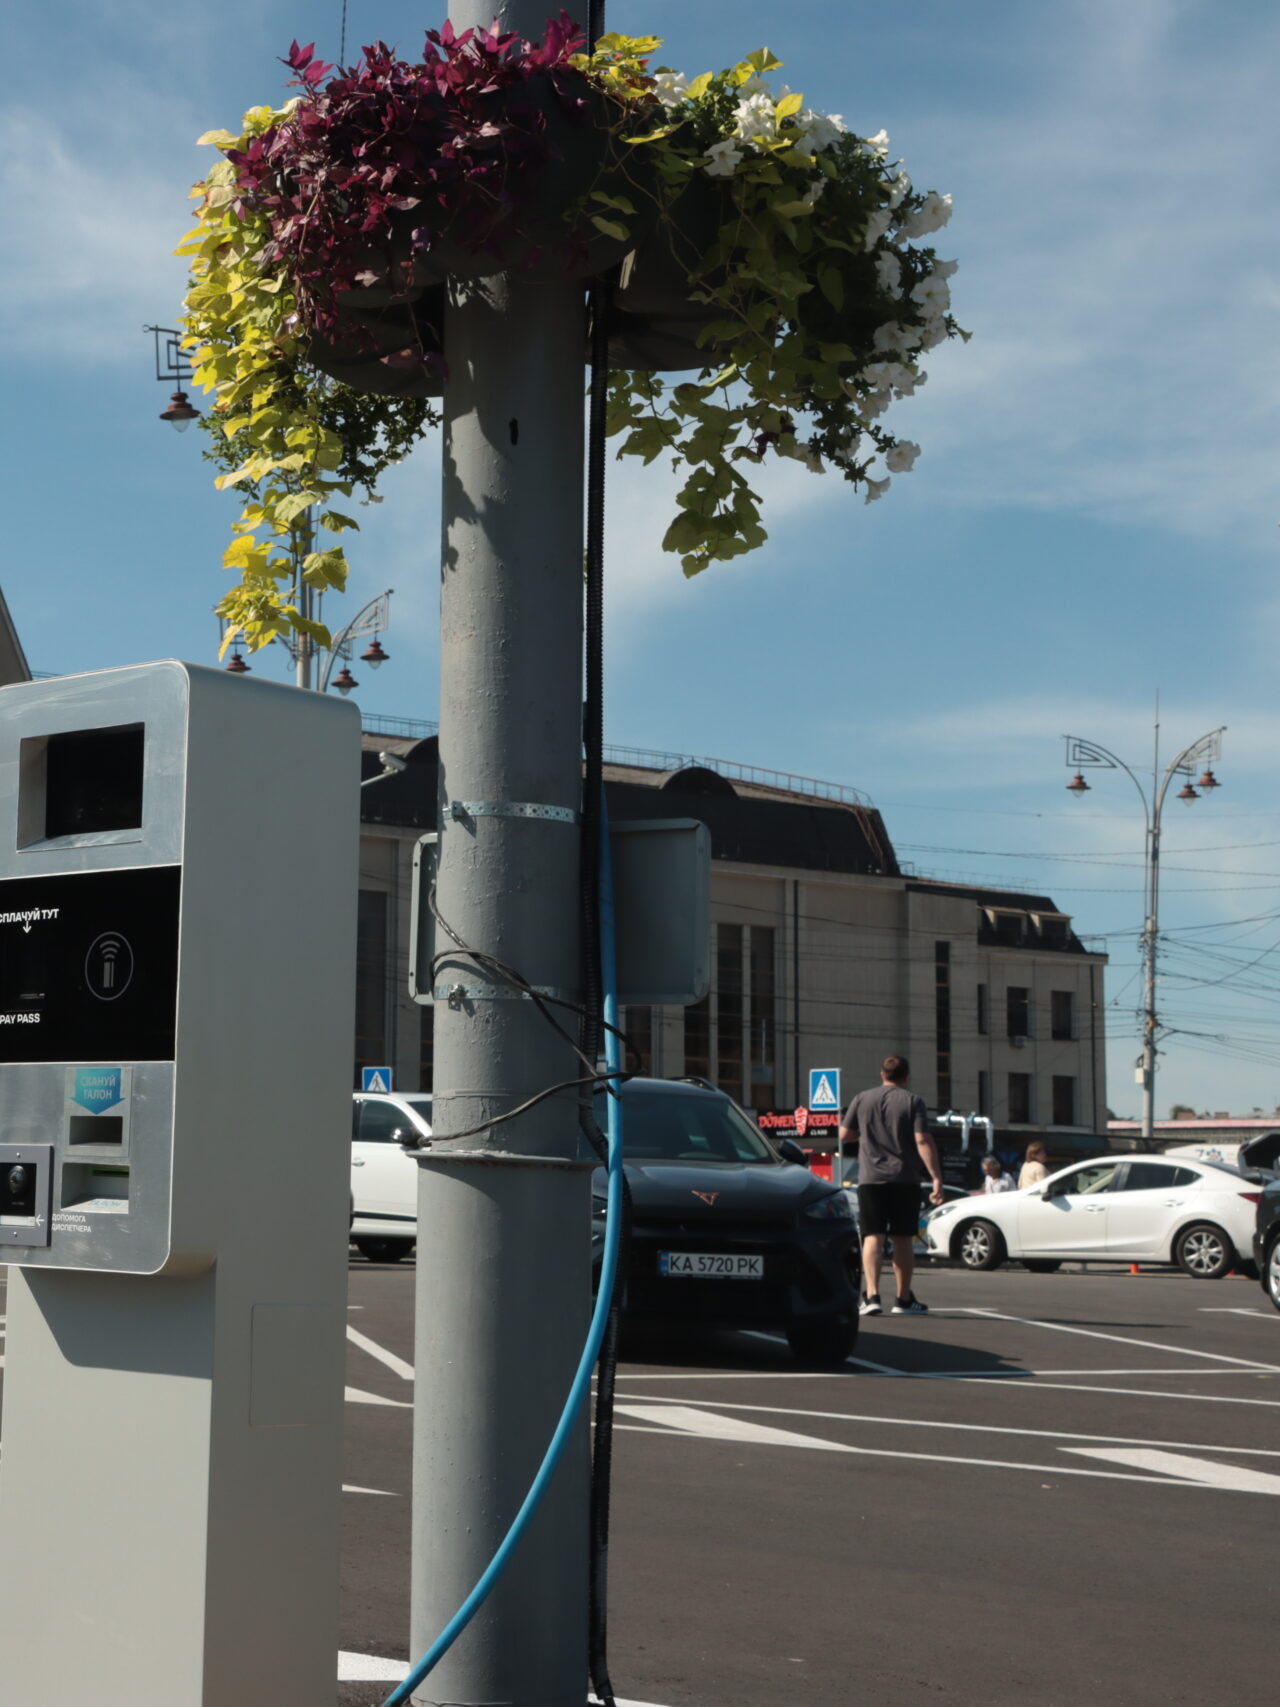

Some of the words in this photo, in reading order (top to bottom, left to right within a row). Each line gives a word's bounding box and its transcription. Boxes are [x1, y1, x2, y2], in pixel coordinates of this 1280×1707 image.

[41, 908, 59, 920] ТУТ
[0, 1014, 16, 1024] PAY
[17, 1013, 41, 1023] PASS
[81, 1075, 116, 1087] СКАНУЙ
[83, 1089, 113, 1100] ТАЛОН
[52, 1213, 86, 1223] ДОПОМОГА
[670, 1256, 693, 1272] KA
[698, 1256, 734, 1273] 5720
[737, 1258, 760, 1274] PK
